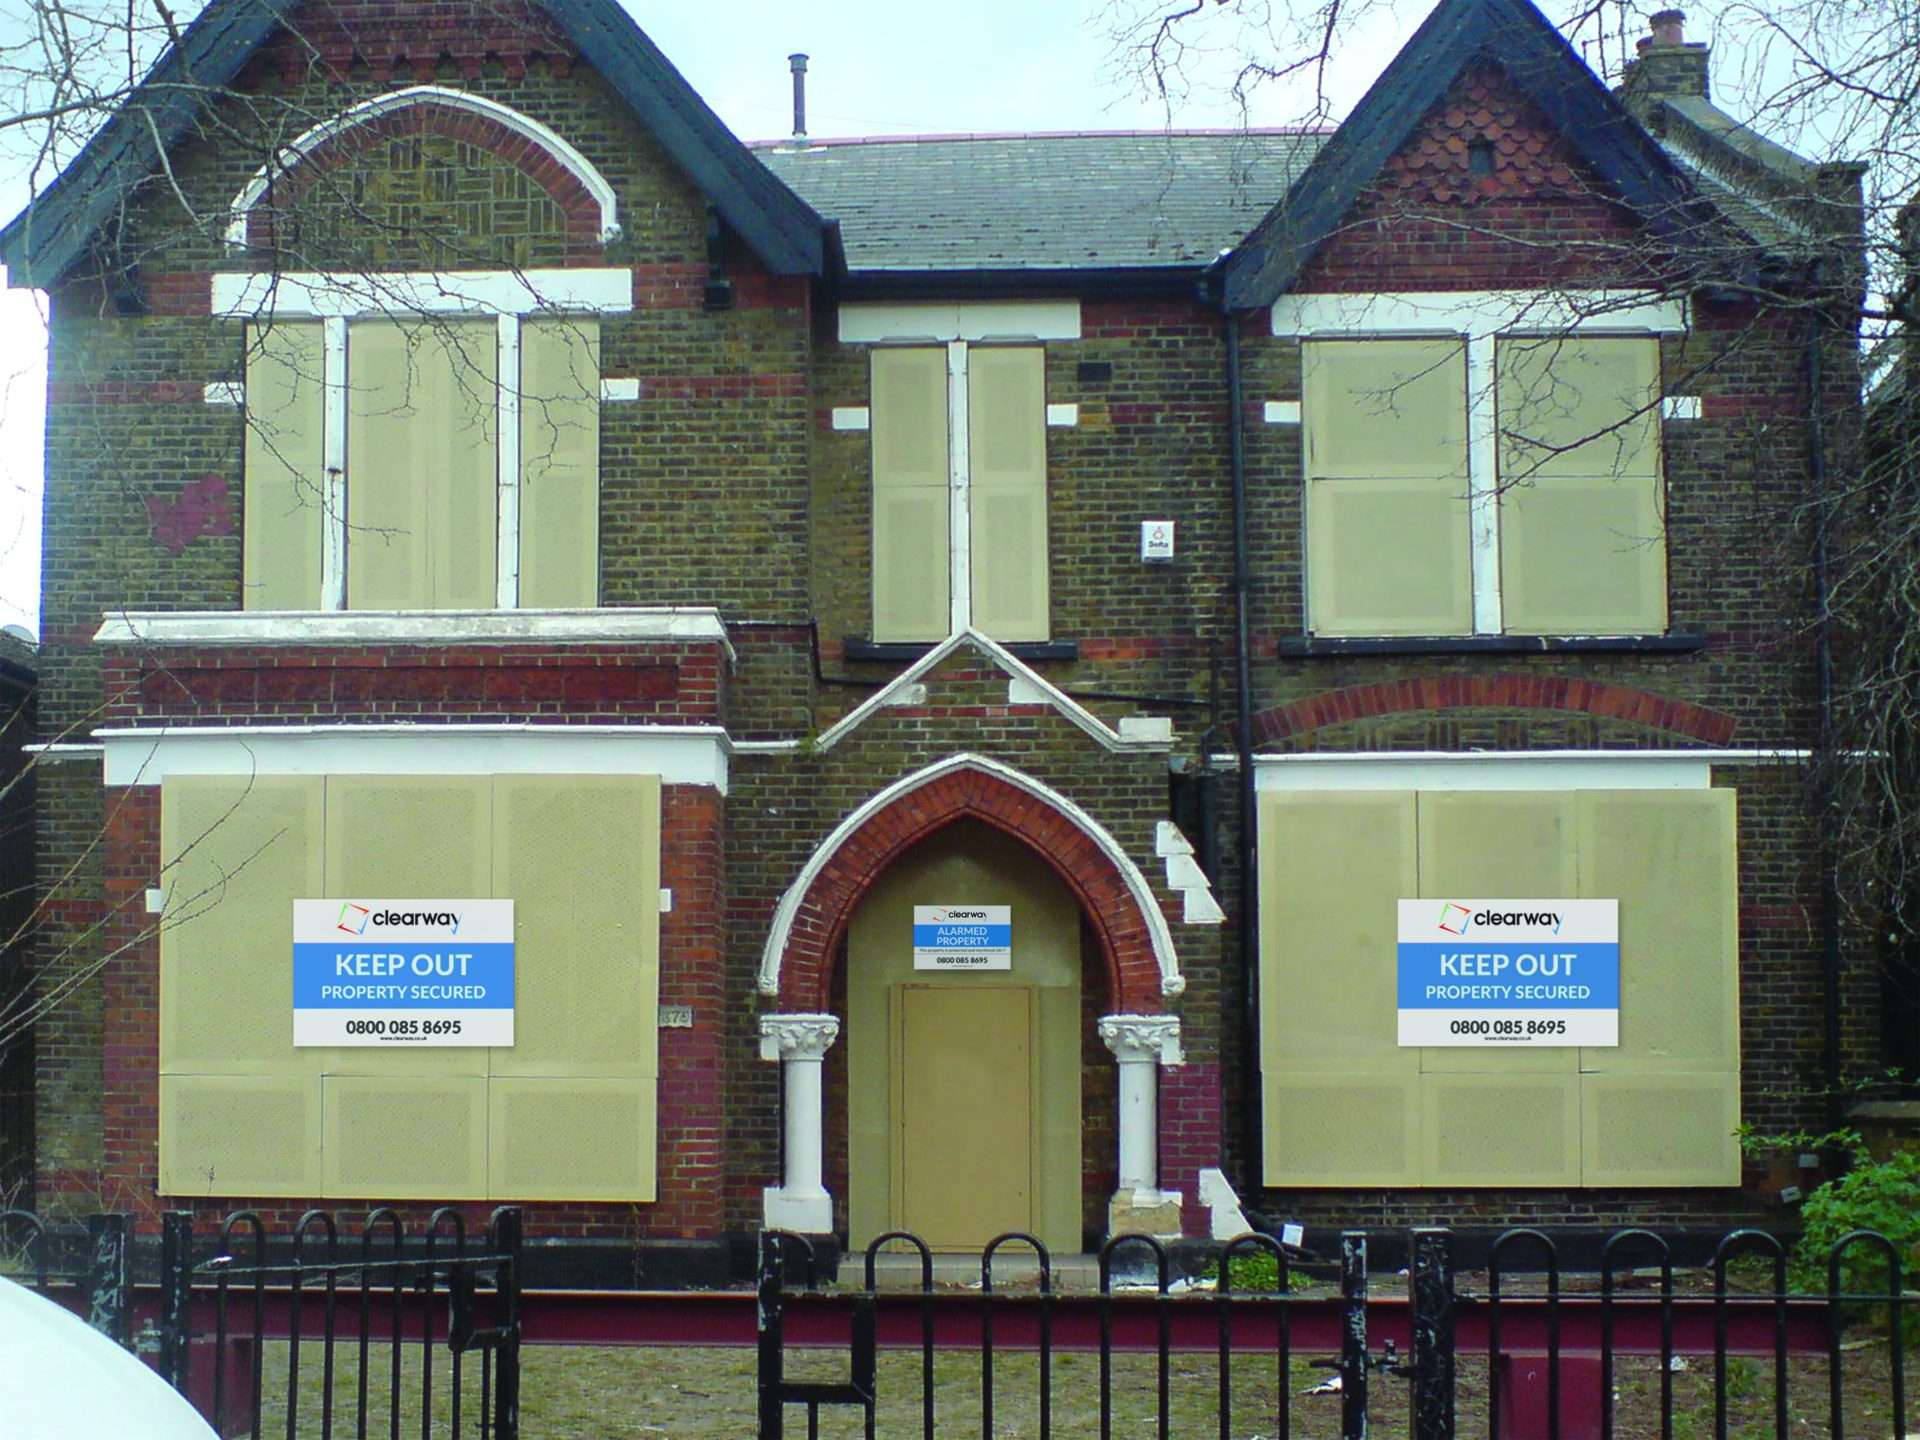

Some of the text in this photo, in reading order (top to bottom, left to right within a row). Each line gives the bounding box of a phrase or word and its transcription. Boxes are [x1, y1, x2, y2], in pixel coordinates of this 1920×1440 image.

[372, 910, 464, 935] clearway
[1474, 910, 1565, 935] clearway
[937, 927, 988, 936] ALARMED
[936, 937, 989, 945] PROPERTY
[335, 954, 472, 976] KEEP OUT
[936, 956, 988, 964] 0800 085 8695
[1440, 954, 1577, 976] KEEP OUT
[321, 985, 486, 999] PROPERTY SECURED
[1426, 985, 1591, 999] PROPERTY SECURED
[346, 1020, 461, 1034] 0800 085 8695
[1450, 1020, 1566, 1034] 0800 085 8695
